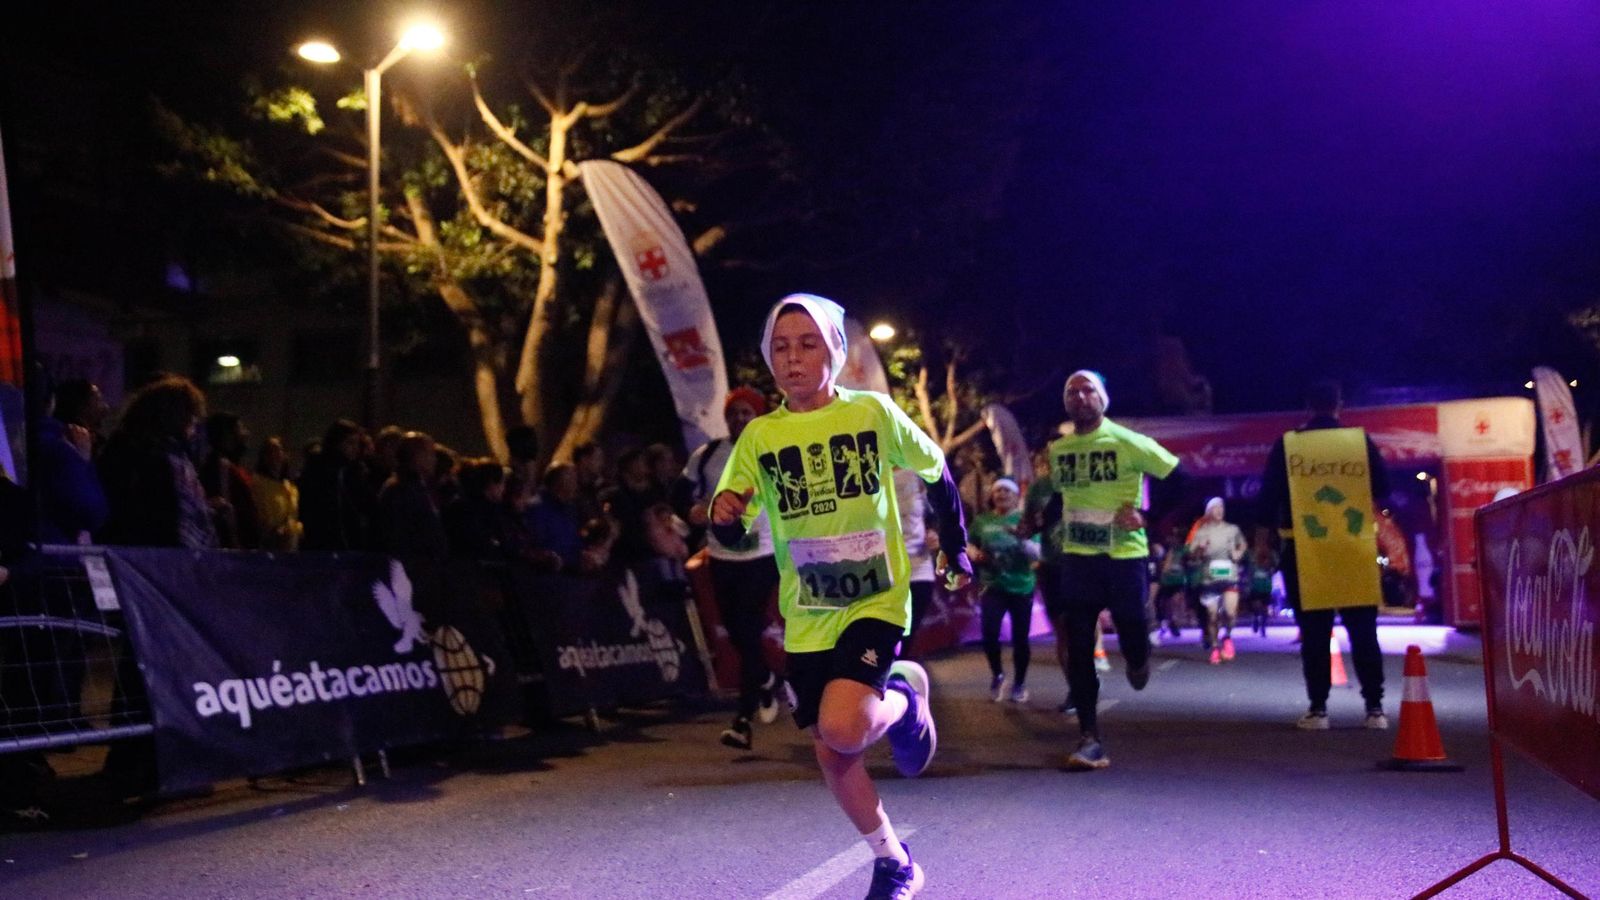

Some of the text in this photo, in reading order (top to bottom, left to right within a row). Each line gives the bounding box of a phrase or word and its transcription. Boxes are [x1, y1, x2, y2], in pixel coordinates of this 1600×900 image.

[812, 500, 835, 514] 2024
[805, 568, 881, 599] 1201
[192, 659, 438, 729] aquéatacamos
